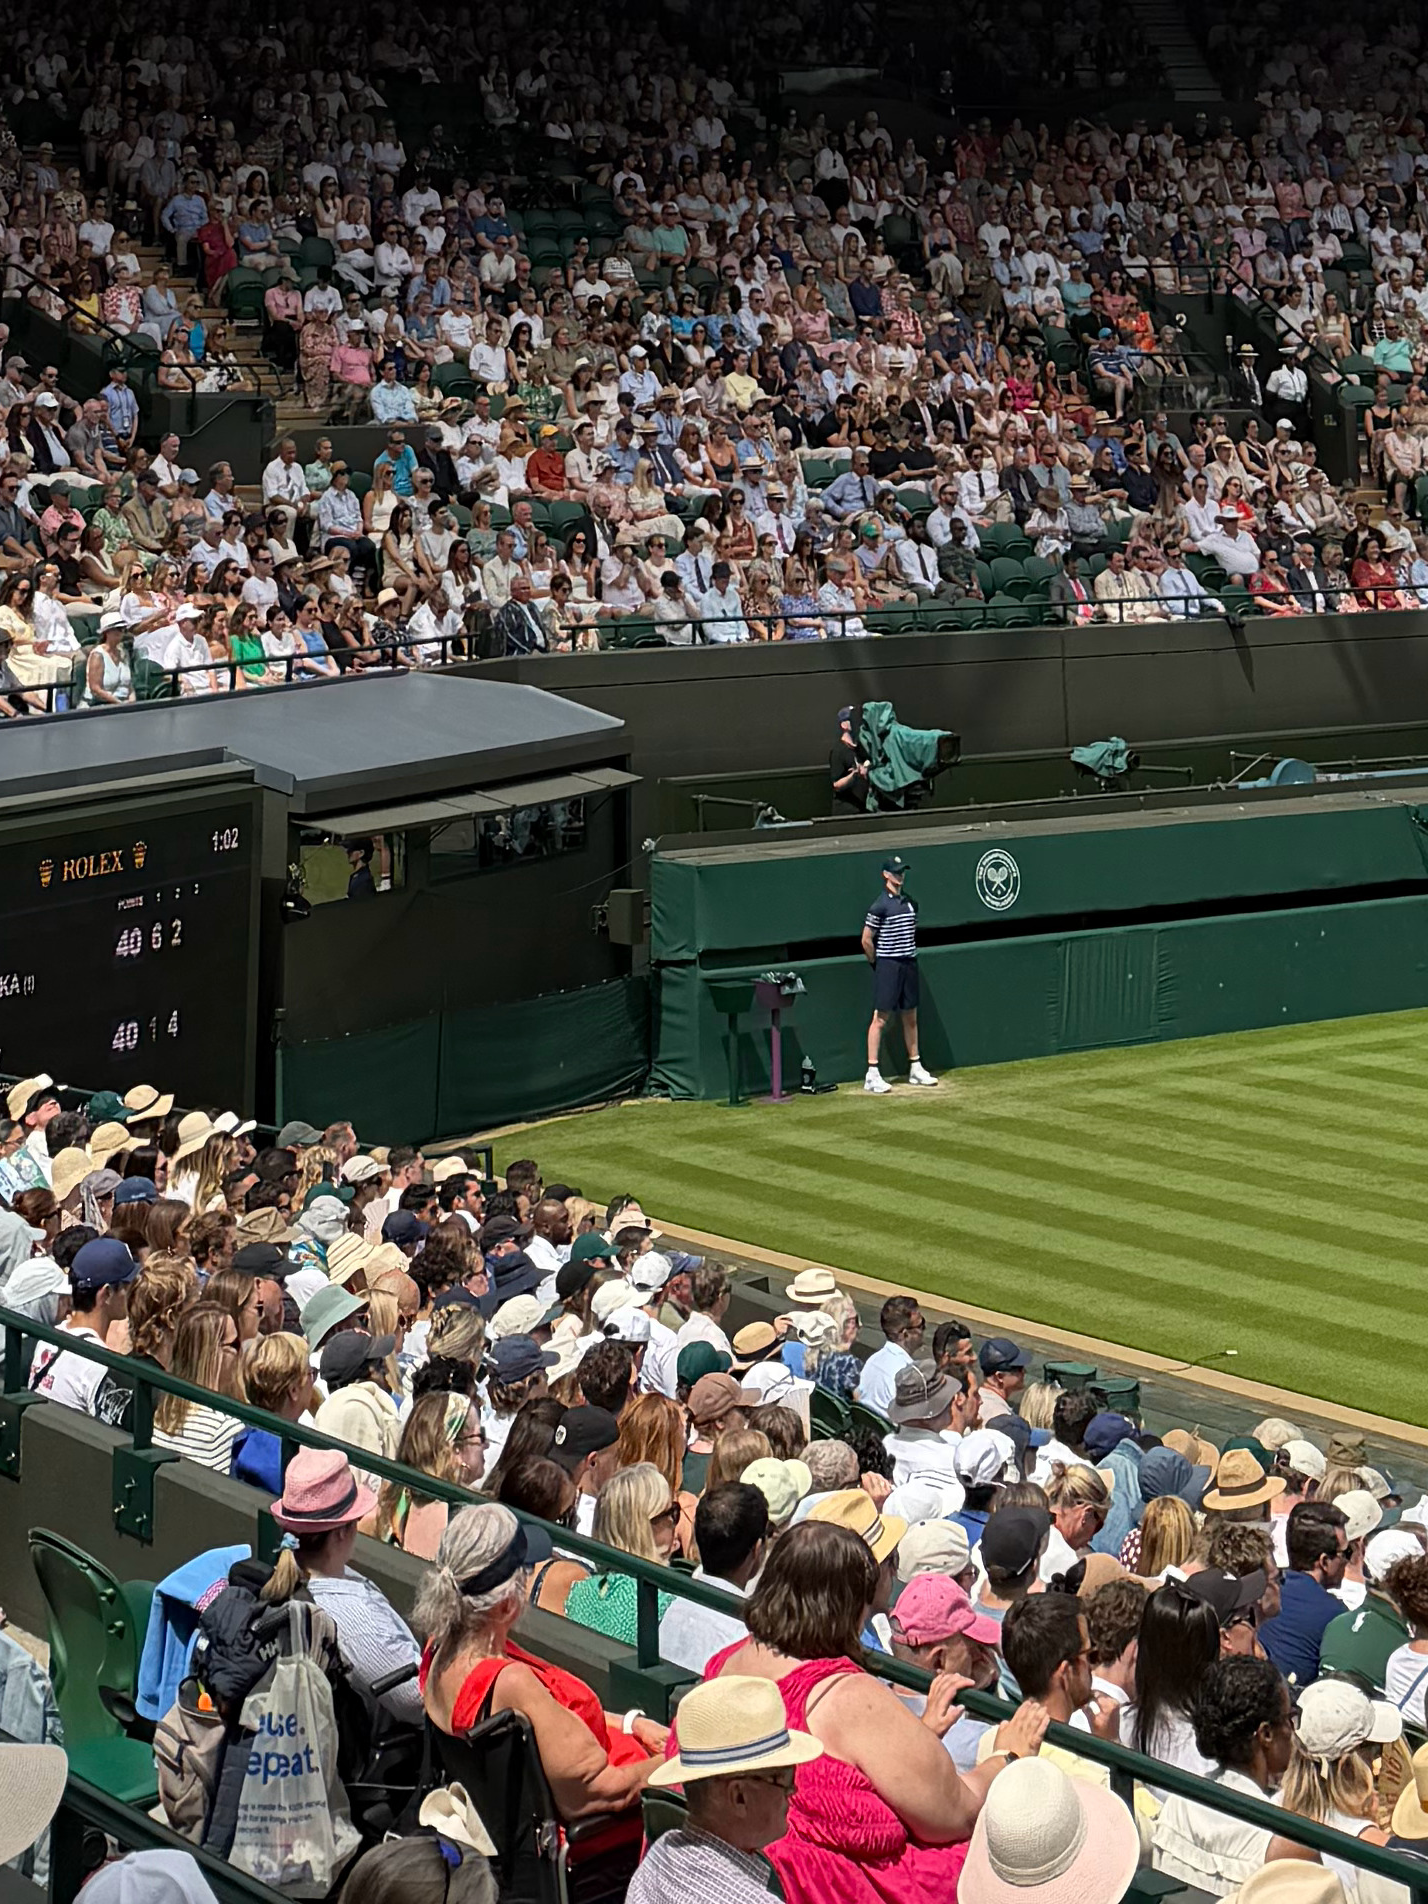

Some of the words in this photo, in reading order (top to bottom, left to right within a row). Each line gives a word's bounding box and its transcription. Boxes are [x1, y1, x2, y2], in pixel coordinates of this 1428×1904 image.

[212, 827, 239, 852] 1:02
[62, 849, 124, 882] ROLEX
[115, 927, 143, 957] 40
[152, 921, 162, 950] 6
[172, 918, 182, 946] 2
[112, 1021, 139, 1052] 40
[149, 1016, 157, 1042] 1
[167, 1010, 178, 1037] 4
[246, 1742, 320, 1786] epeat.
